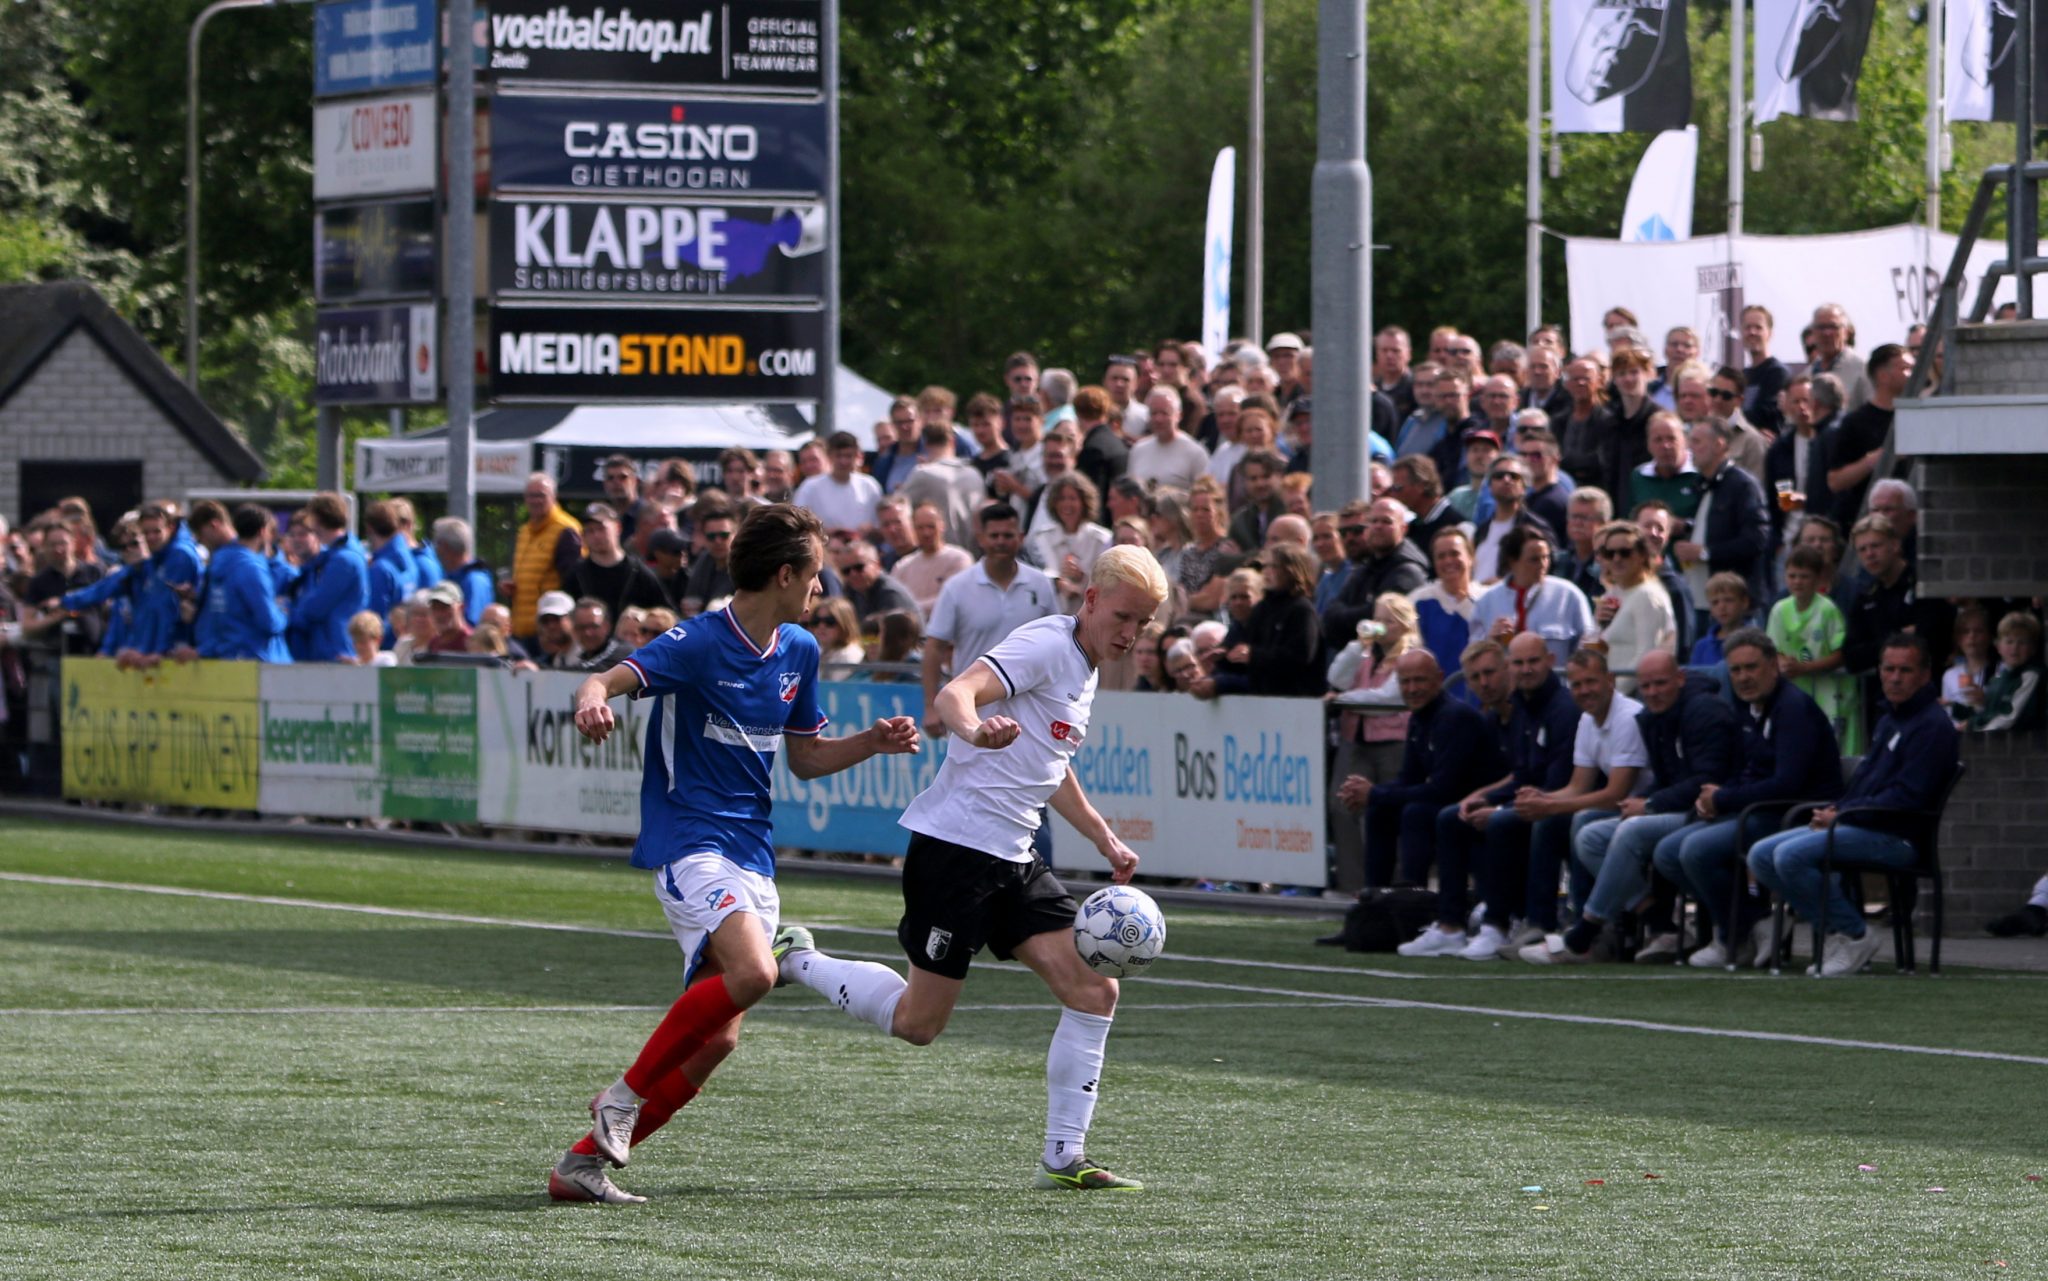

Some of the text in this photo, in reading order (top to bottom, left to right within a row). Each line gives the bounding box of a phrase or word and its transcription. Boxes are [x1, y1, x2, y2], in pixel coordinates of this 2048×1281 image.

[492, 6, 712, 62] voetbalshop.nl
[747, 17, 818, 36] OFFICIAL
[748, 36, 818, 54] PARTNER
[732, 53, 818, 72] TEAMWEAR
[564, 106, 759, 161] CASINO
[571, 164, 750, 188] GIETHOORN
[514, 204, 727, 270] KLAPPE
[514, 268, 727, 295] Schildersbedrijf
[317, 324, 405, 384] Rabobank
[1175, 732, 1313, 806] Bos Bedden
